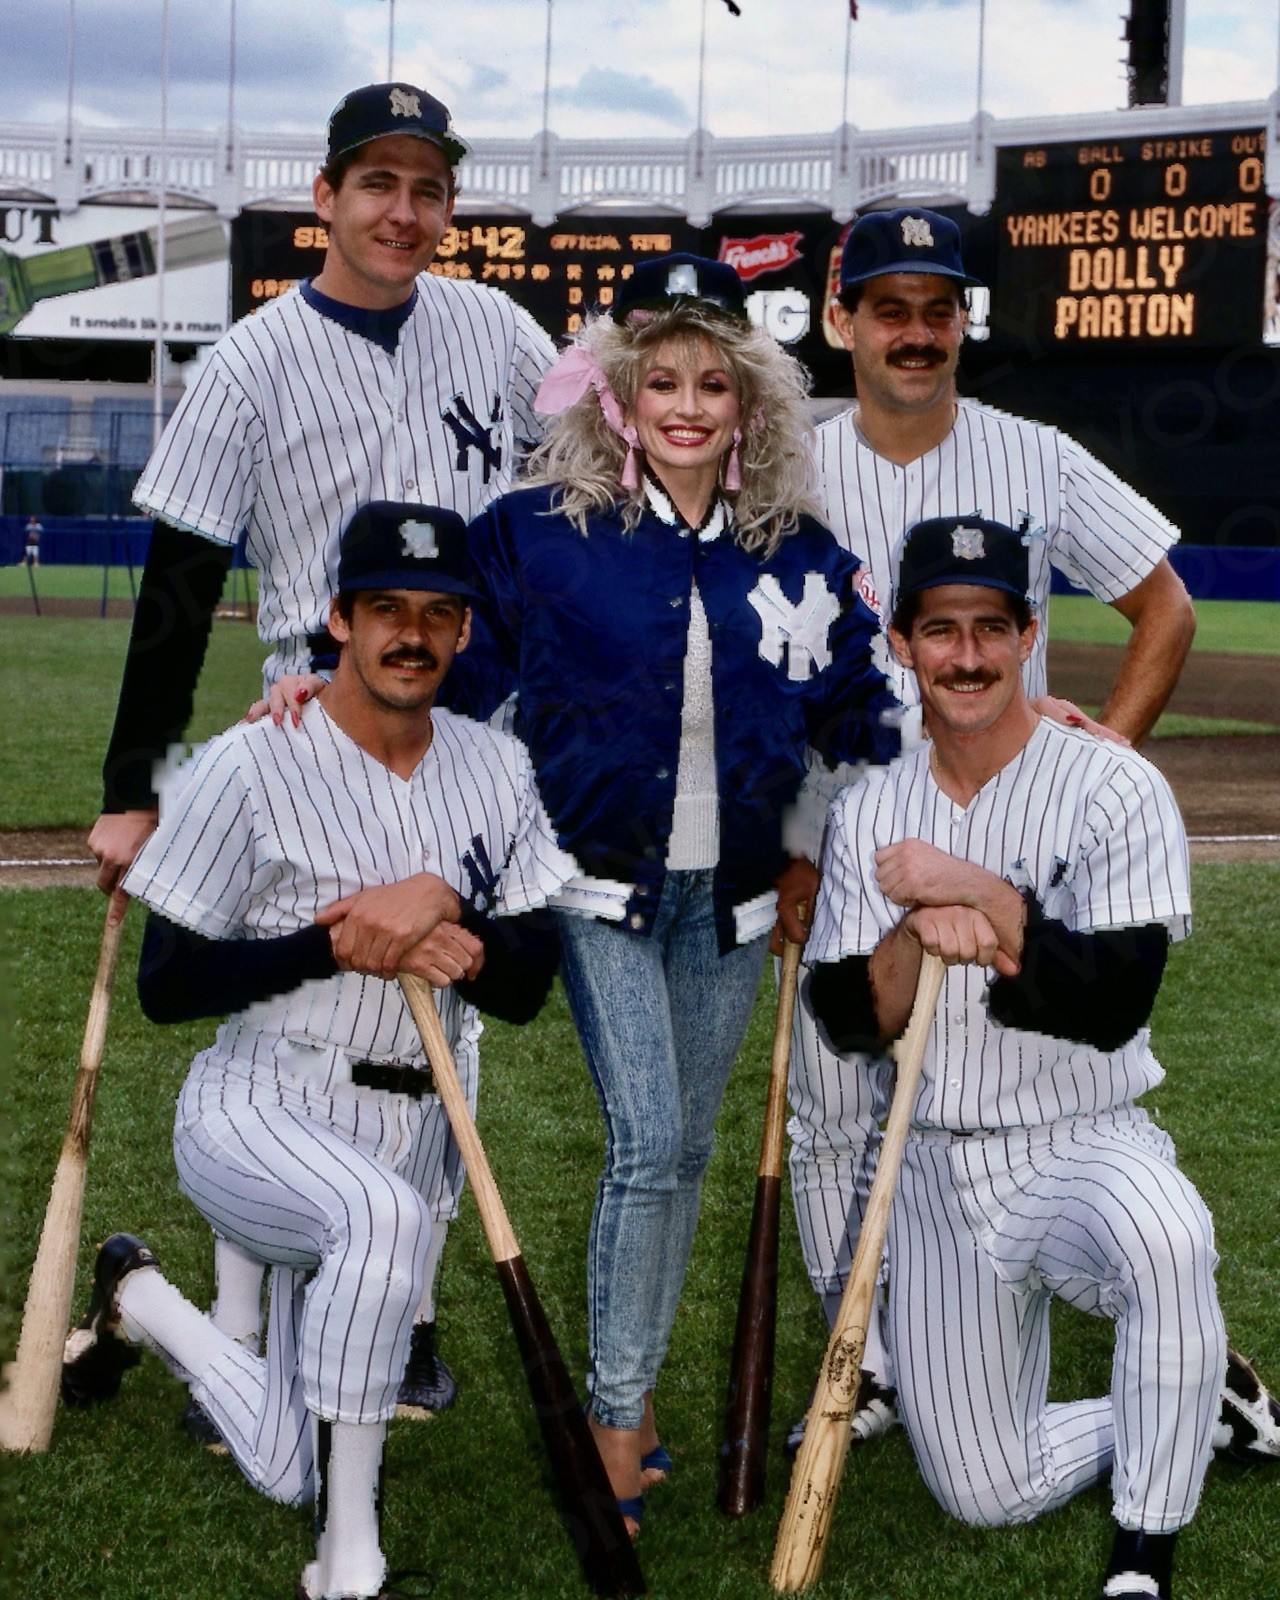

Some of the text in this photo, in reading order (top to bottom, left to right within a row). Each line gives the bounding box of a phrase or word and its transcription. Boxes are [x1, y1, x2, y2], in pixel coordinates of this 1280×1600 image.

[1078, 146, 1124, 164] BALL
[1141, 138, 1212, 161] STRIKE
[1089, 157, 1263, 200] 0 0 0
[1007, 202, 1256, 246] YANKEES WELCOME
[1068, 245, 1185, 291] DOLLY
[85, 316, 137, 330] smells
[187, 321, 222, 332] man
[1054, 293, 1194, 339] PARTON
[746, 570, 842, 682] NY
